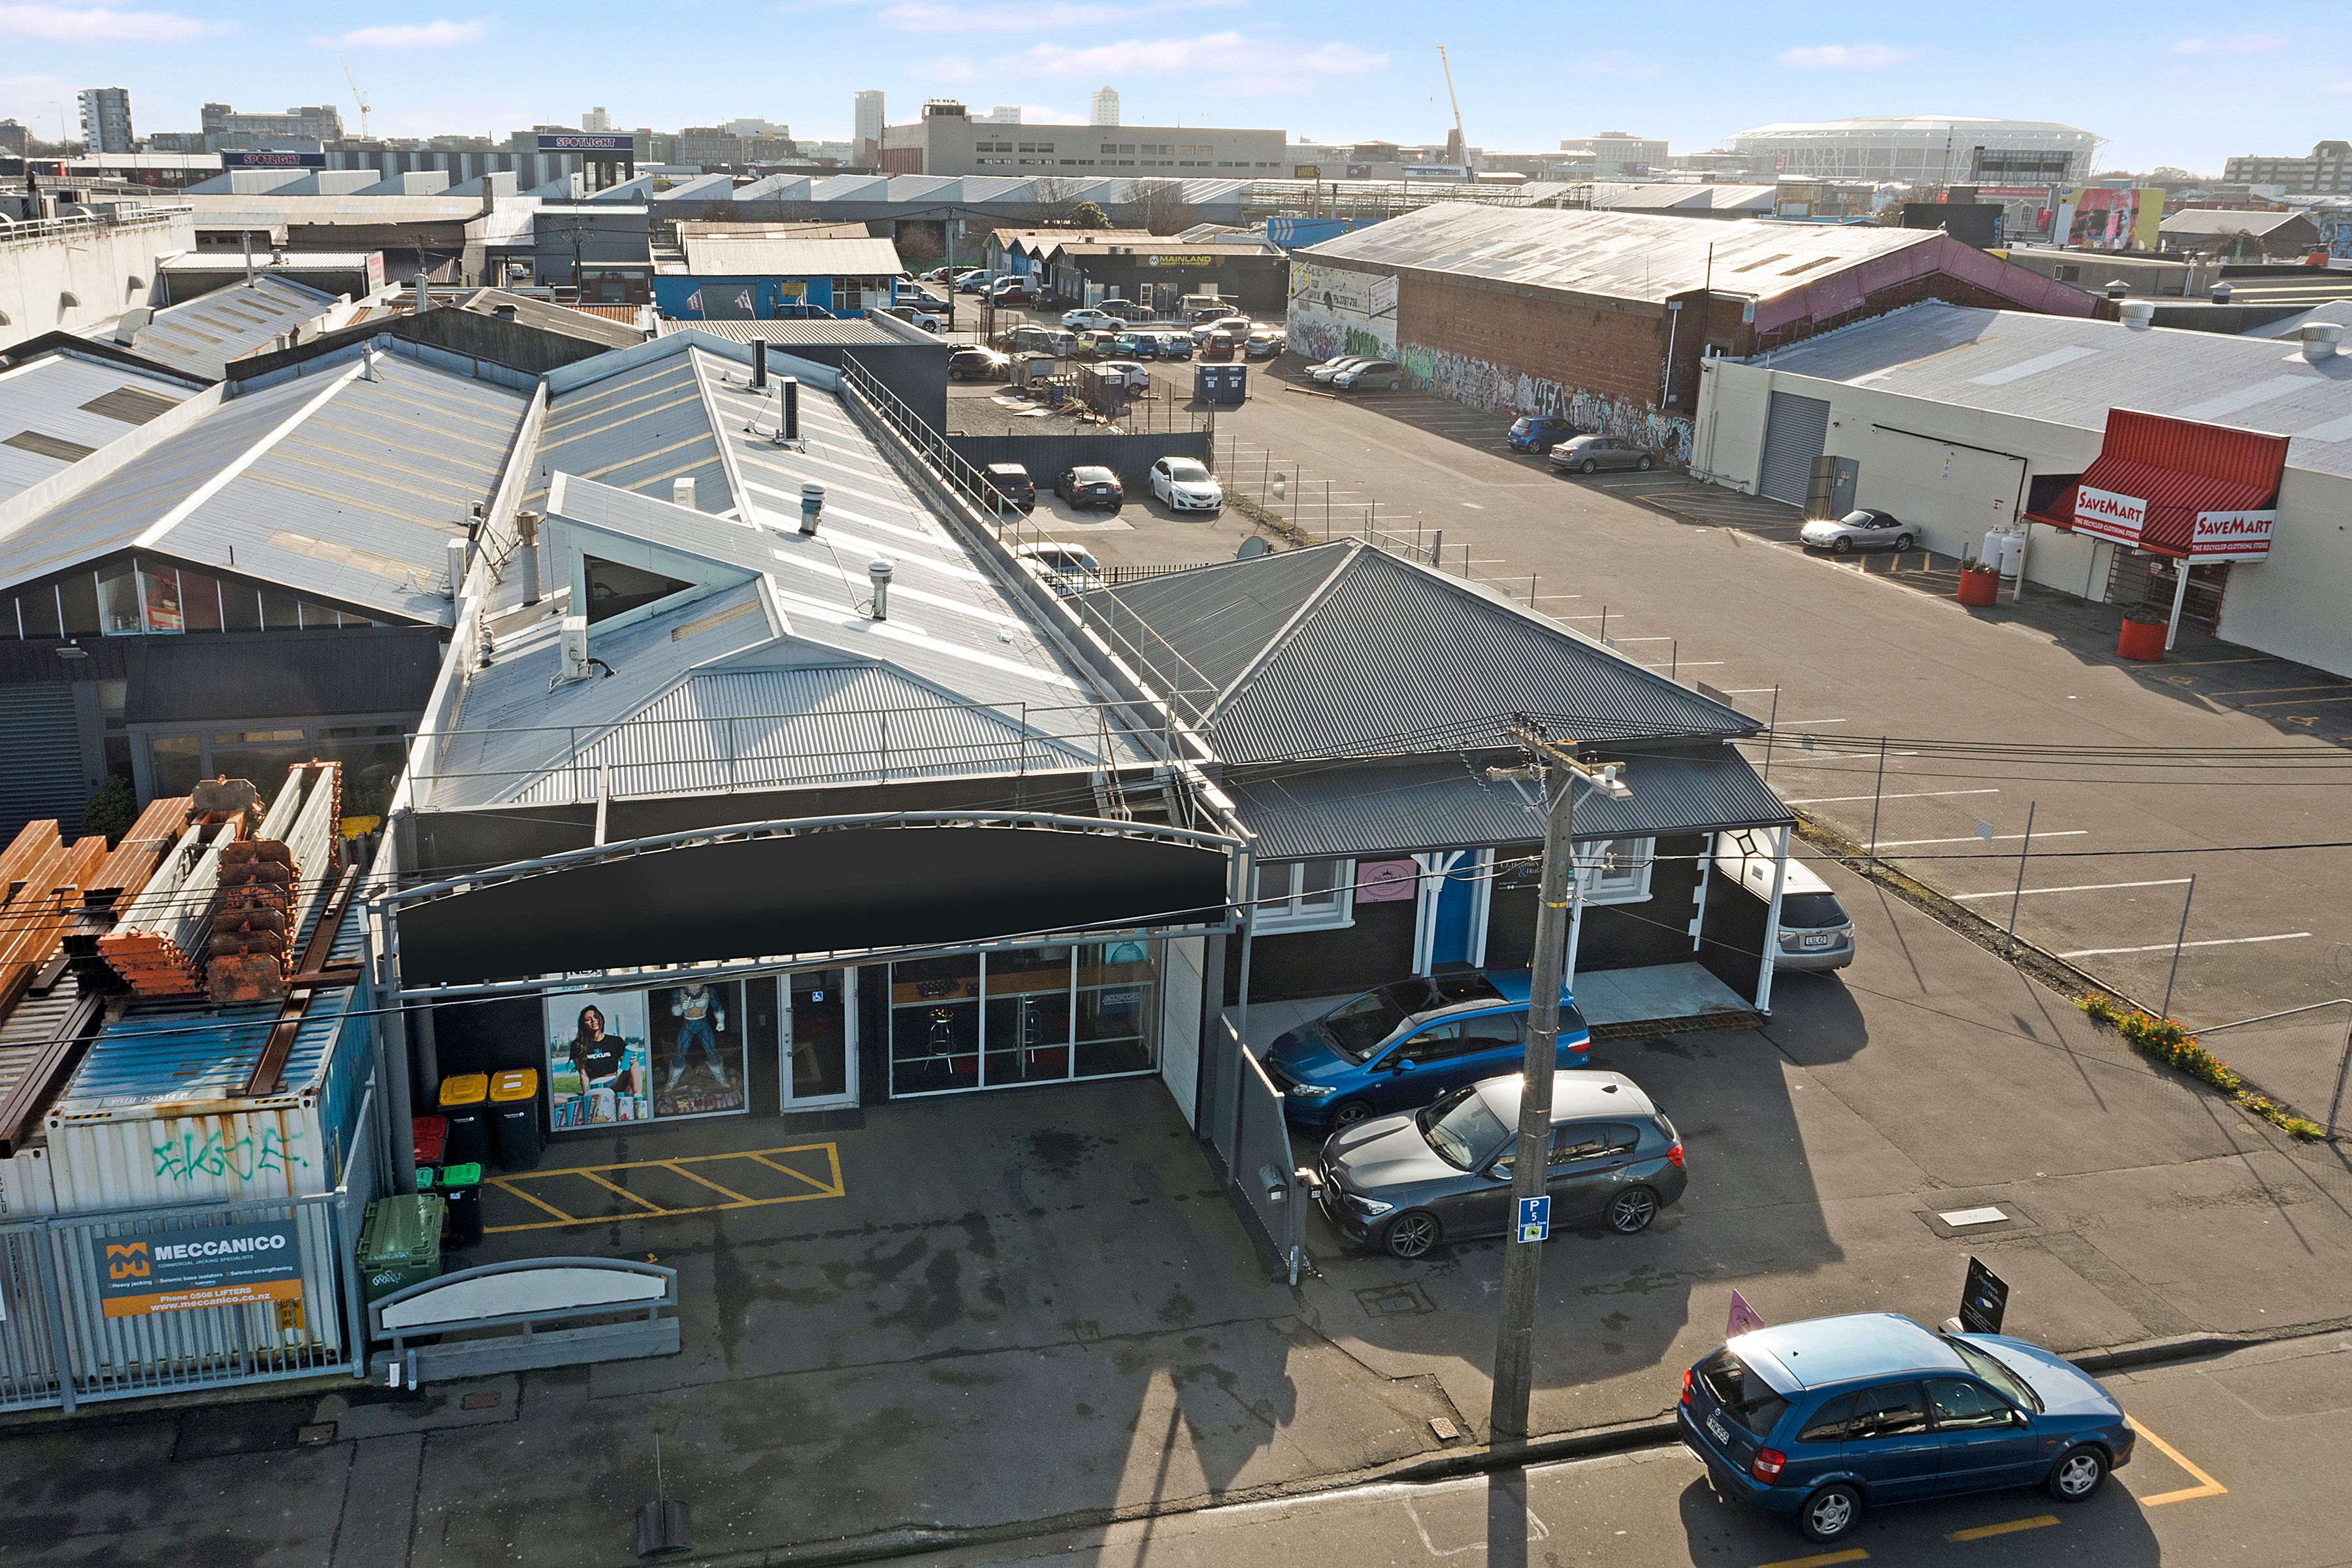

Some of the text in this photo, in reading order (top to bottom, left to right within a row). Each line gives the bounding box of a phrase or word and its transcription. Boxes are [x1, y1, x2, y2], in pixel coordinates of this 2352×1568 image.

[557, 137, 615, 147] SPOTLIGHT
[244, 154, 301, 165] SPOTLIGHT
[2083, 519, 2103, 529] RECYCLED
[2104, 525, 2125, 535] CLOTHING
[2125, 531, 2140, 539] STORE
[1529, 1200, 1540, 1212] P
[1531, 1212, 1537, 1221] 5
[154, 1234, 286, 1261] MECCANICO
[195, 1257, 220, 1266] JACKING
[220, 1254, 254, 1263] SPECIALISTS
[214, 1287, 252, 1297] LIFTERS
[150, 1293, 270, 1311] www.meccanico.co.nz
